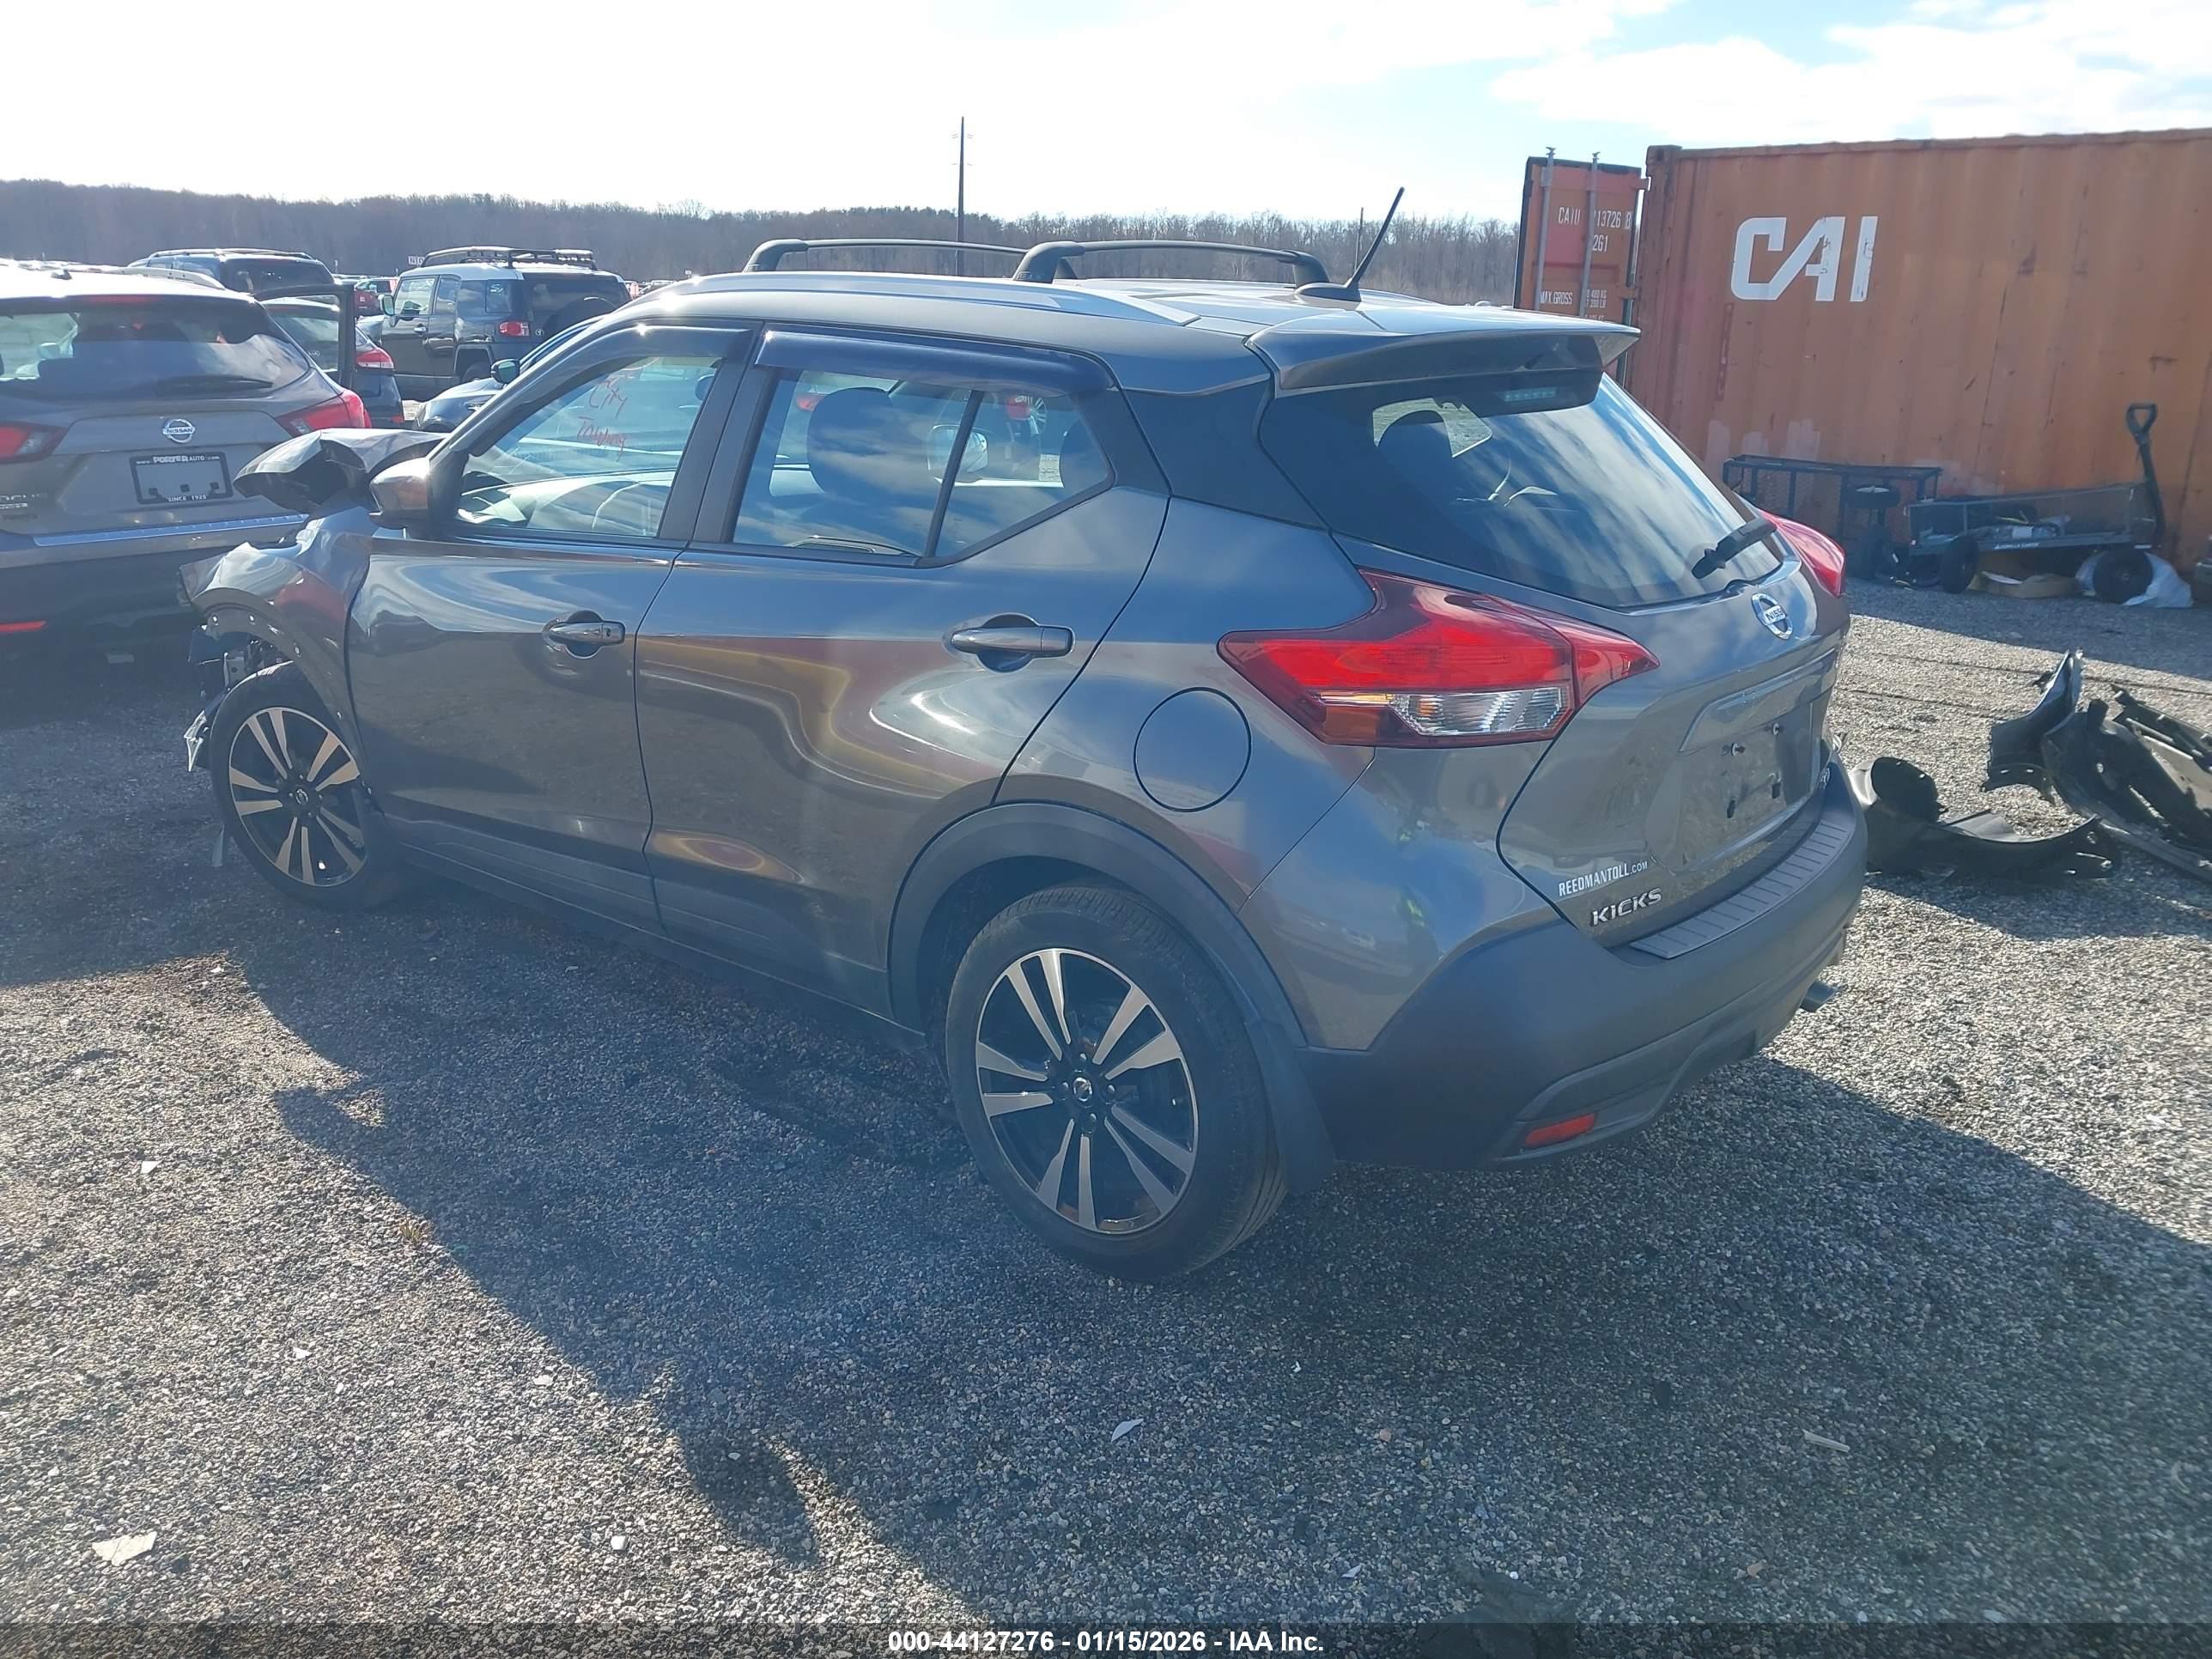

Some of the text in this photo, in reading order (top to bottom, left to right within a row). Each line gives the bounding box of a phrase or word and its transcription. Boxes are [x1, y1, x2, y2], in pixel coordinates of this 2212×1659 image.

[1559, 206, 1581, 226] CAIU
[1731, 216, 1878, 301] CAI
[1559, 860, 1648, 896] REEDMANTOLL.COM
[1592, 888, 1662, 926] KICKS
